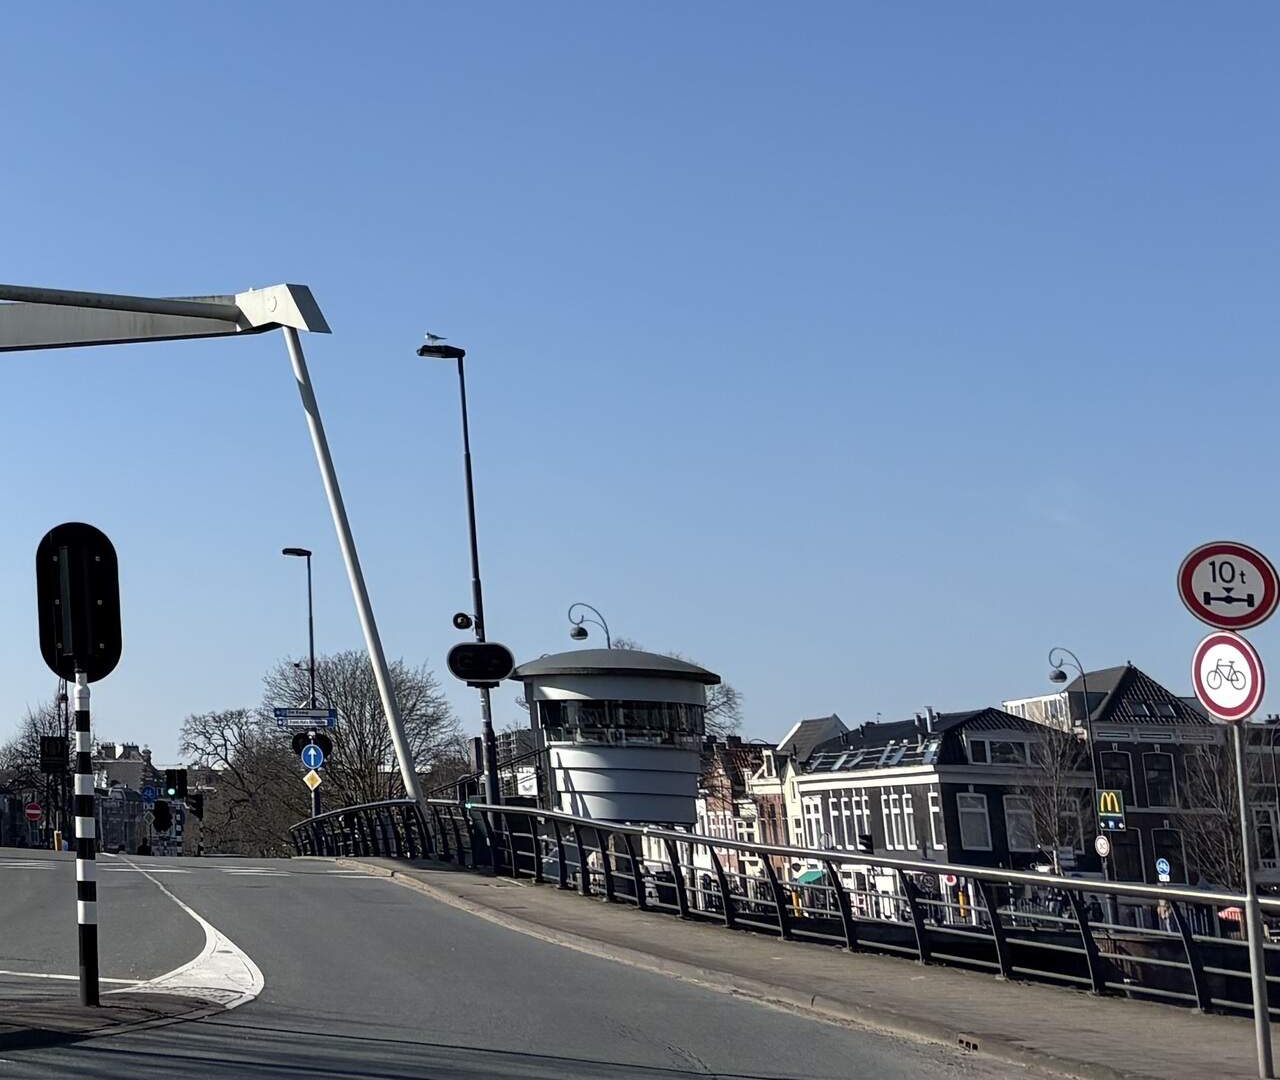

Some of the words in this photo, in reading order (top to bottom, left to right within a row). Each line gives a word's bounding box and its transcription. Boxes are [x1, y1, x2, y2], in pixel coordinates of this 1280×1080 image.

[1208, 560, 1235, 584] 10
[1239, 570, 1246, 584] t
[1100, 792, 1120, 813] M
